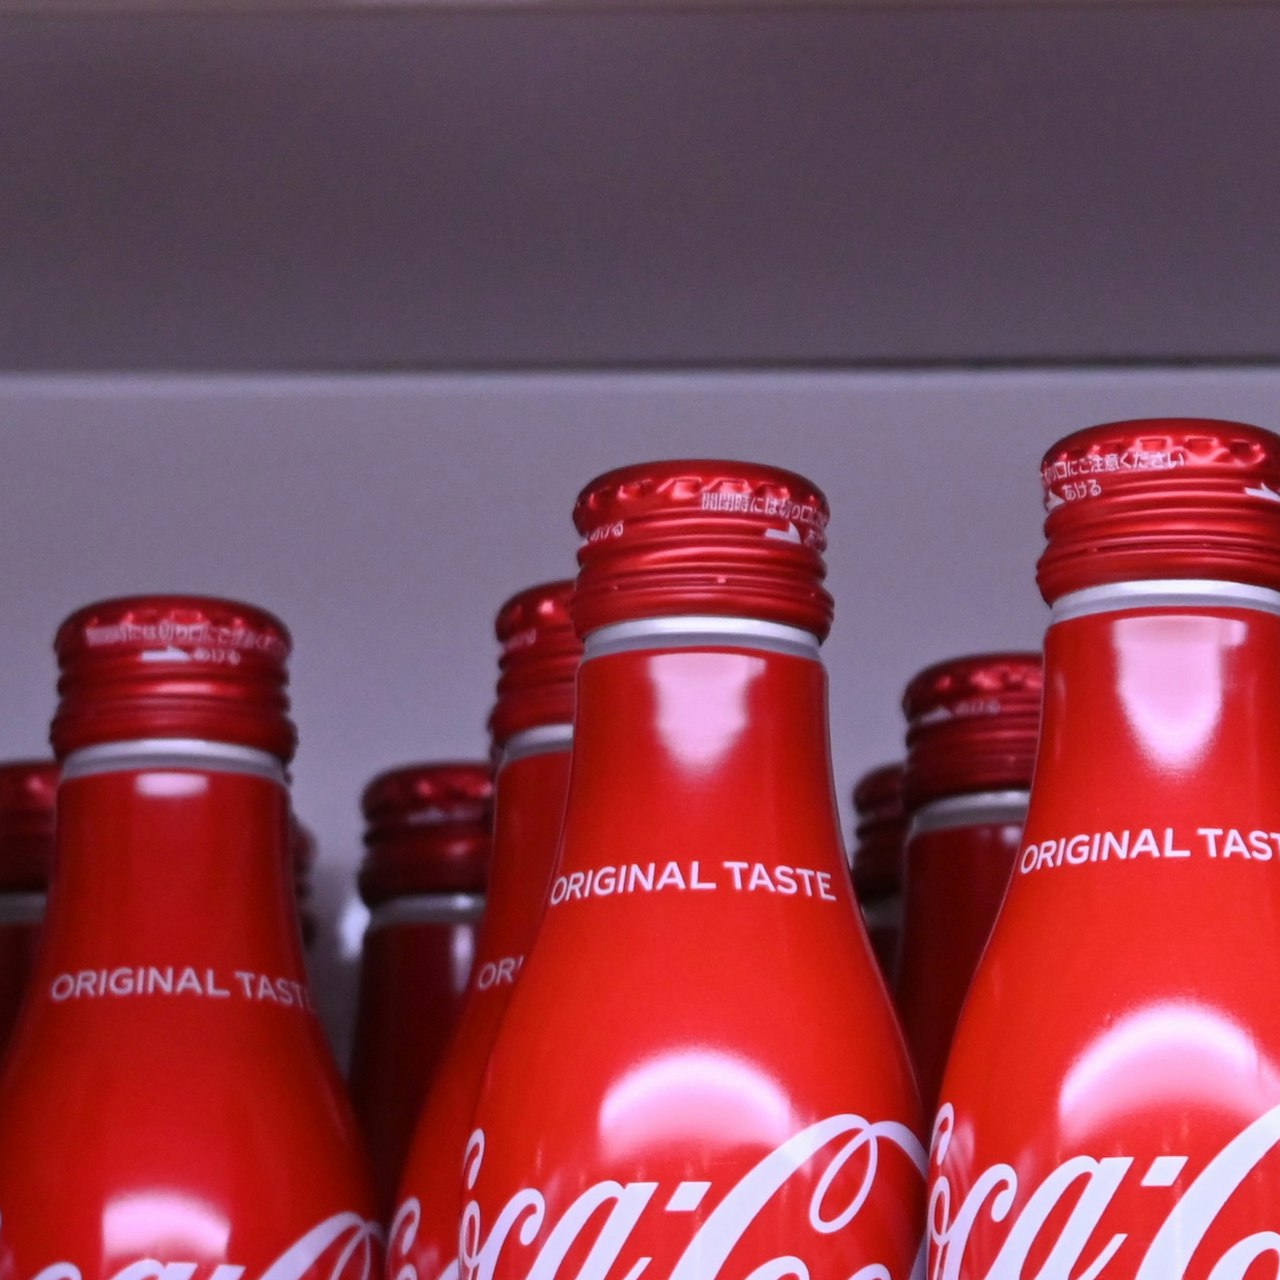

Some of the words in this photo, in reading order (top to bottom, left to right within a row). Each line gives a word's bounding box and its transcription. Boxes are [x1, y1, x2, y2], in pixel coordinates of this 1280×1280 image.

[1020, 828, 1191, 875] ORIGINAL
[551, 861, 716, 905] ORIGINAL
[724, 861, 837, 903] TASTE
[51, 967, 230, 1002] ORIGINAL
[235, 971, 314, 1013] TAST
[477, 954, 526, 991] OR
